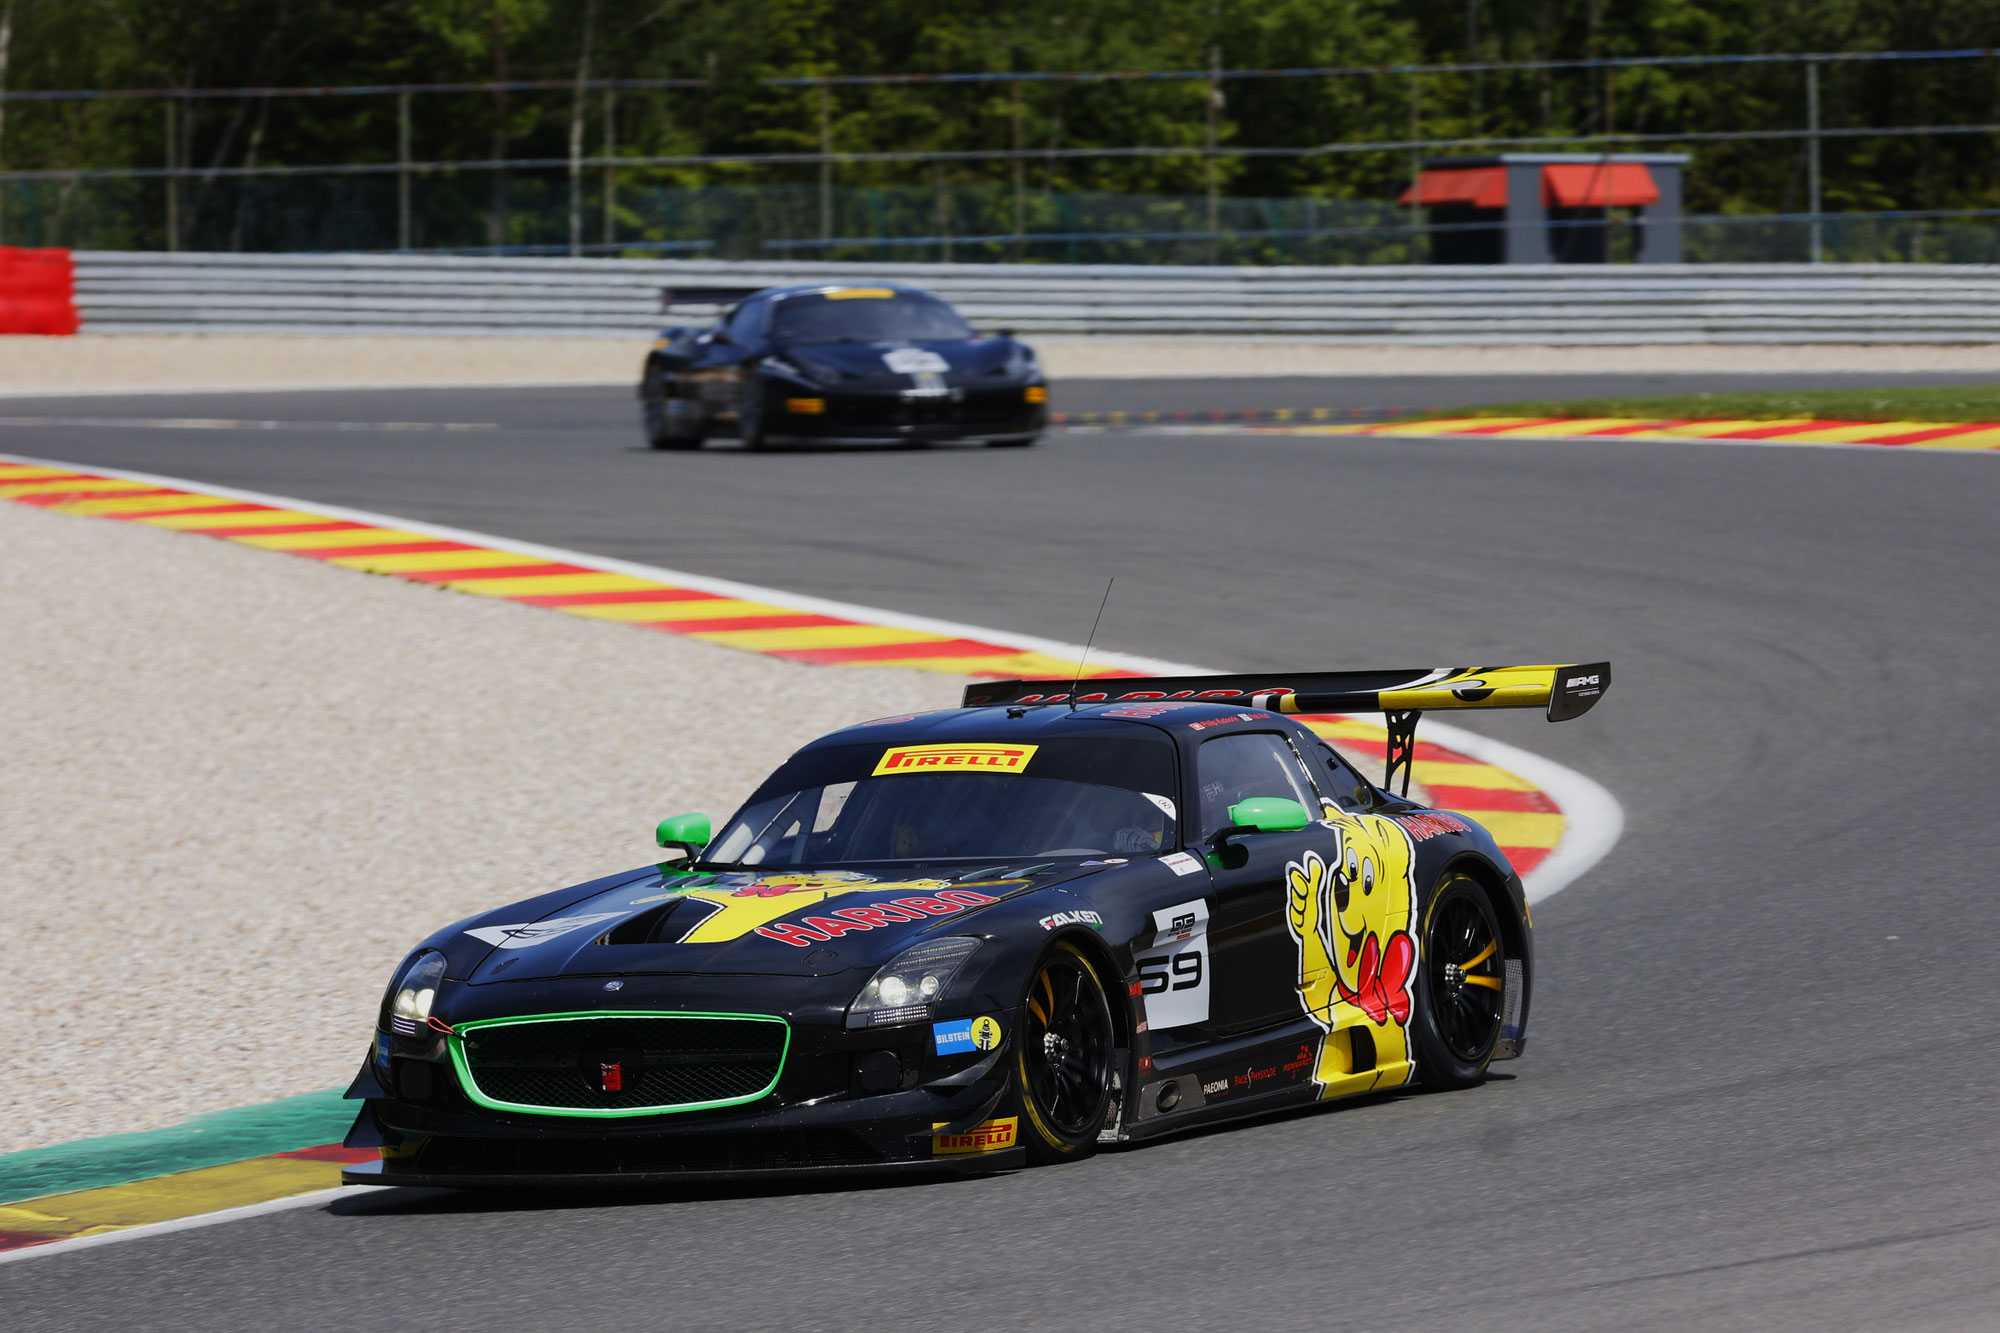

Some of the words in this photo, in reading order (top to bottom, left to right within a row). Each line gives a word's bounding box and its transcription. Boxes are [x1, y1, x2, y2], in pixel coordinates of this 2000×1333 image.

[884, 749, 1025, 769] PIRELLI
[1395, 812, 1473, 843] HARIBO
[754, 889, 1001, 948] HARIBO
[1039, 910, 1104, 931] FALKEN
[936, 1031, 971, 1044] BILSTEIN
[1203, 1078, 1230, 1095] PAEONIA
[940, 1124, 1013, 1148] PIRELLI
